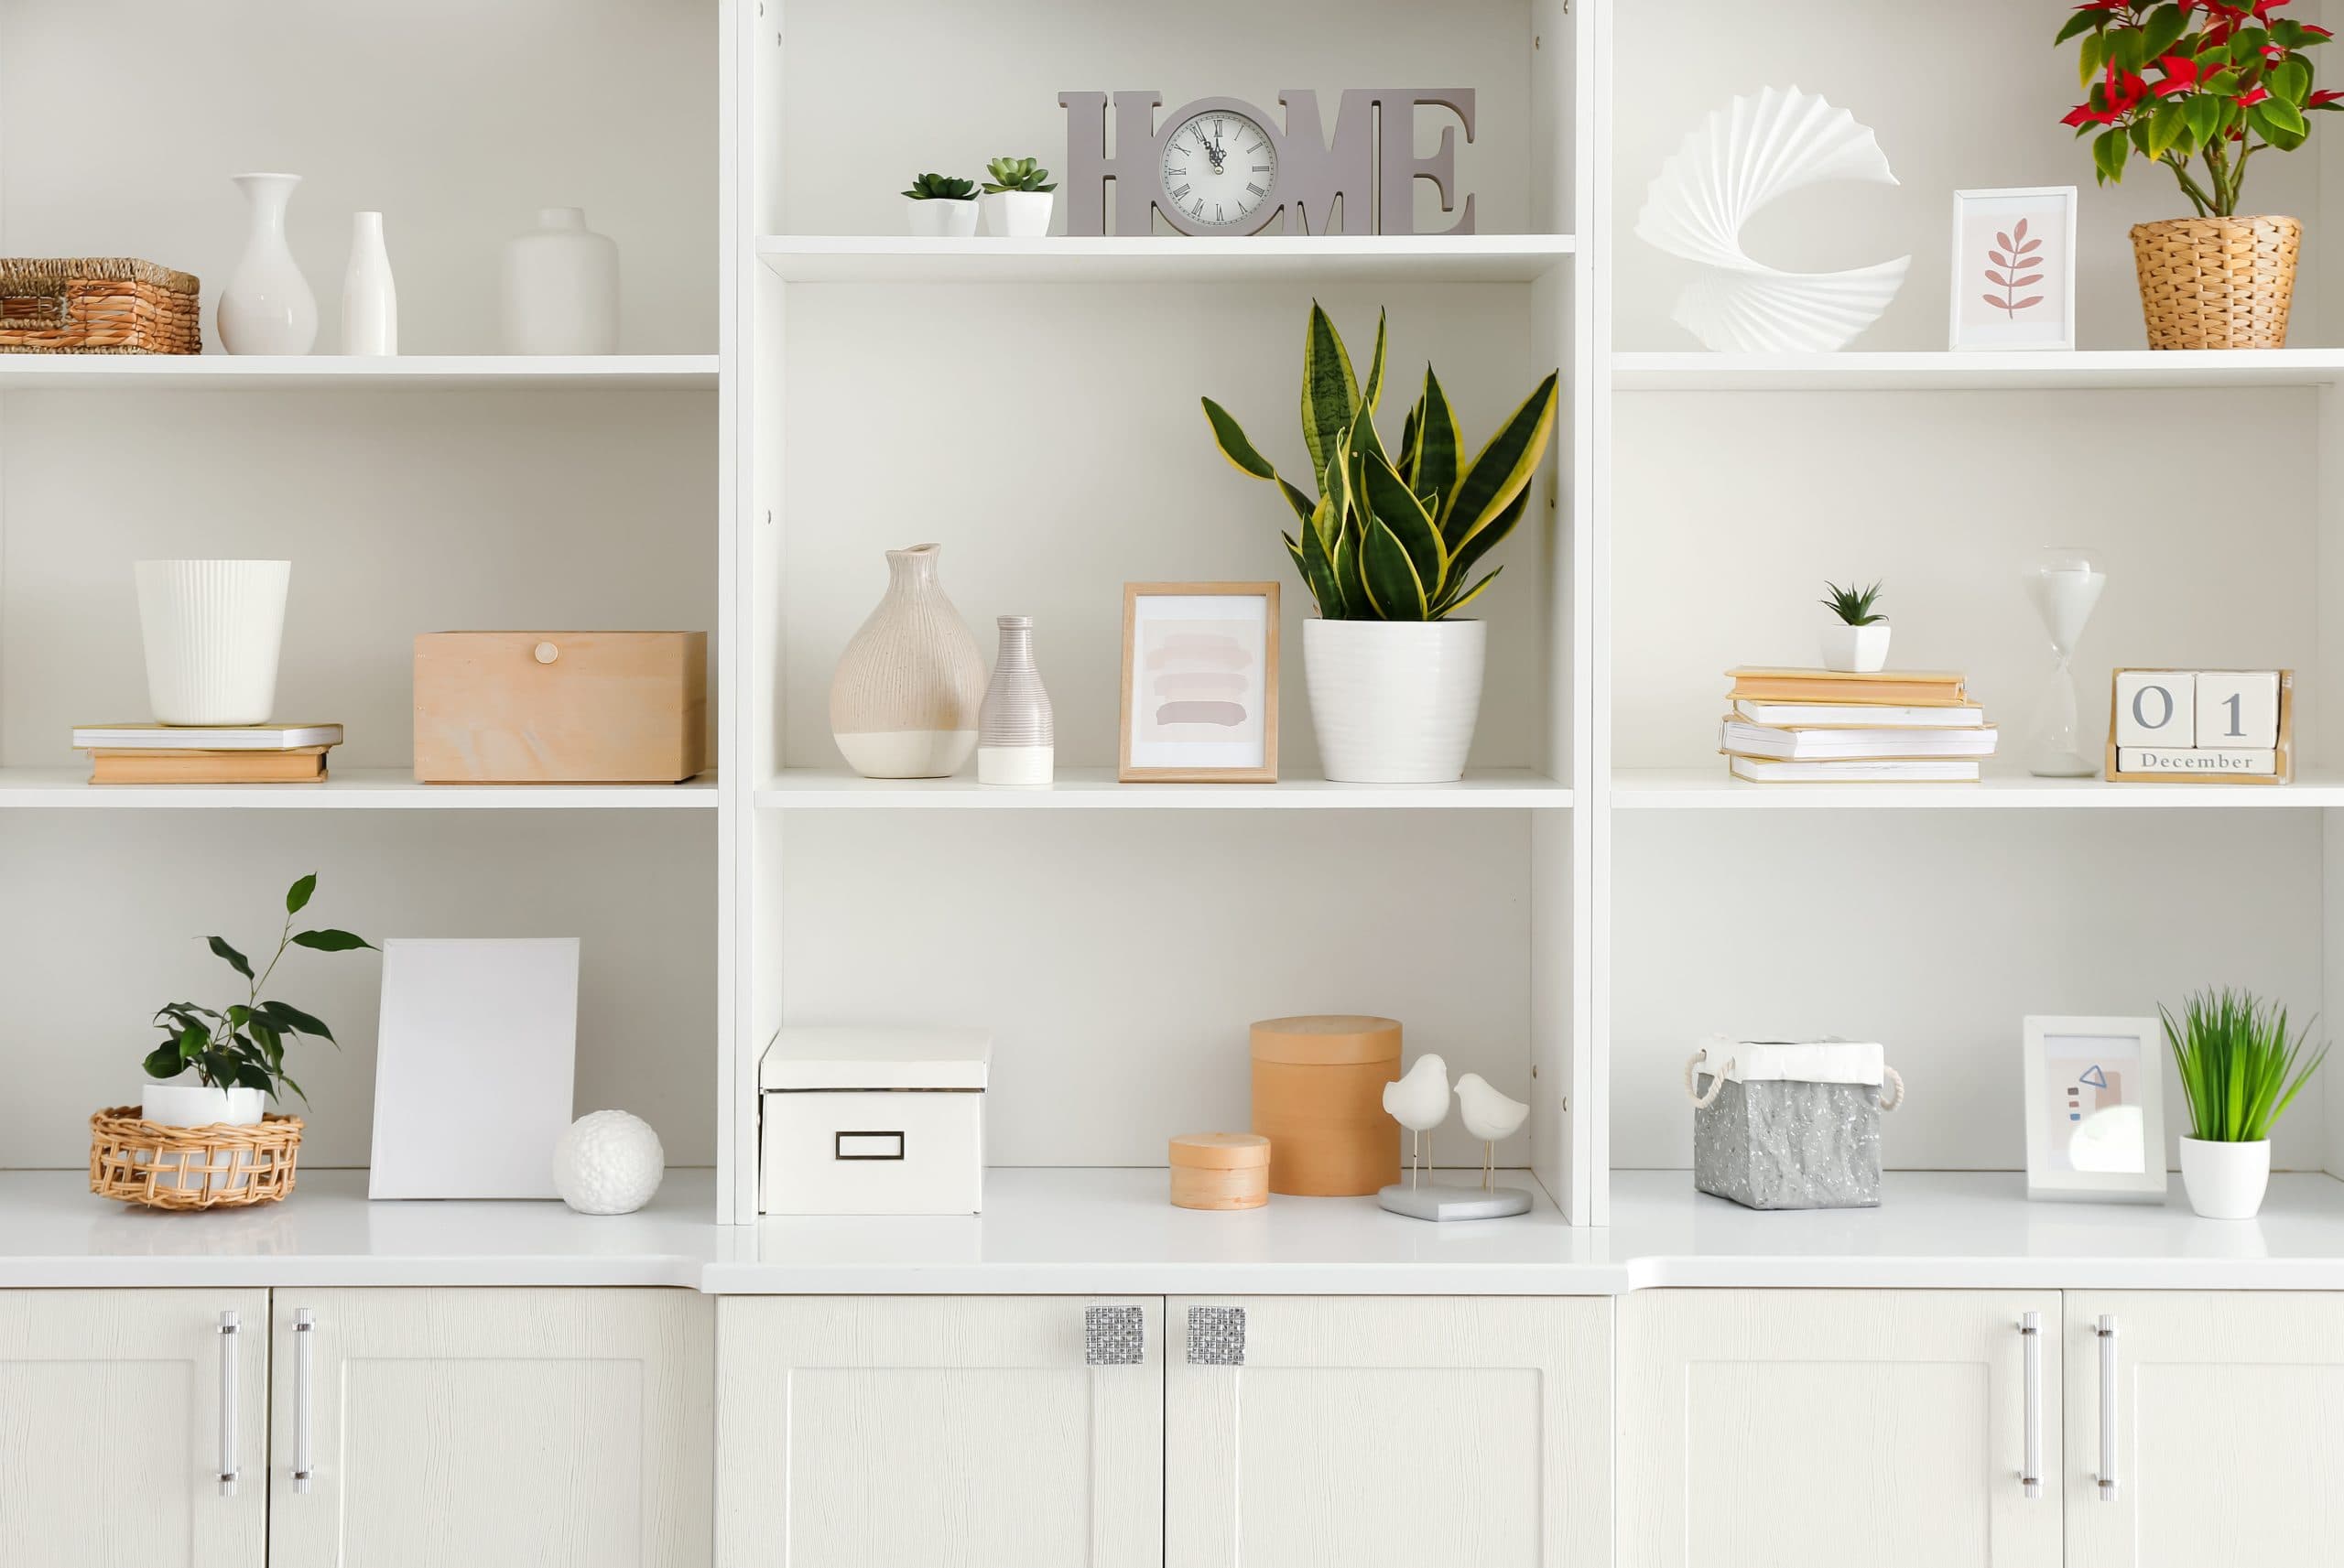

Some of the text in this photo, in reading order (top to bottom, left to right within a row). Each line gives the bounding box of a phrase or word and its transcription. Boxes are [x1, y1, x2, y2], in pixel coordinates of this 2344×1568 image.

[1174, 144, 1191, 157] X
[1246, 142, 1263, 154] II
[1058, 88, 1476, 236] HOME
[1237, 200, 1248, 215] V
[2141, 752, 2253, 769] December
